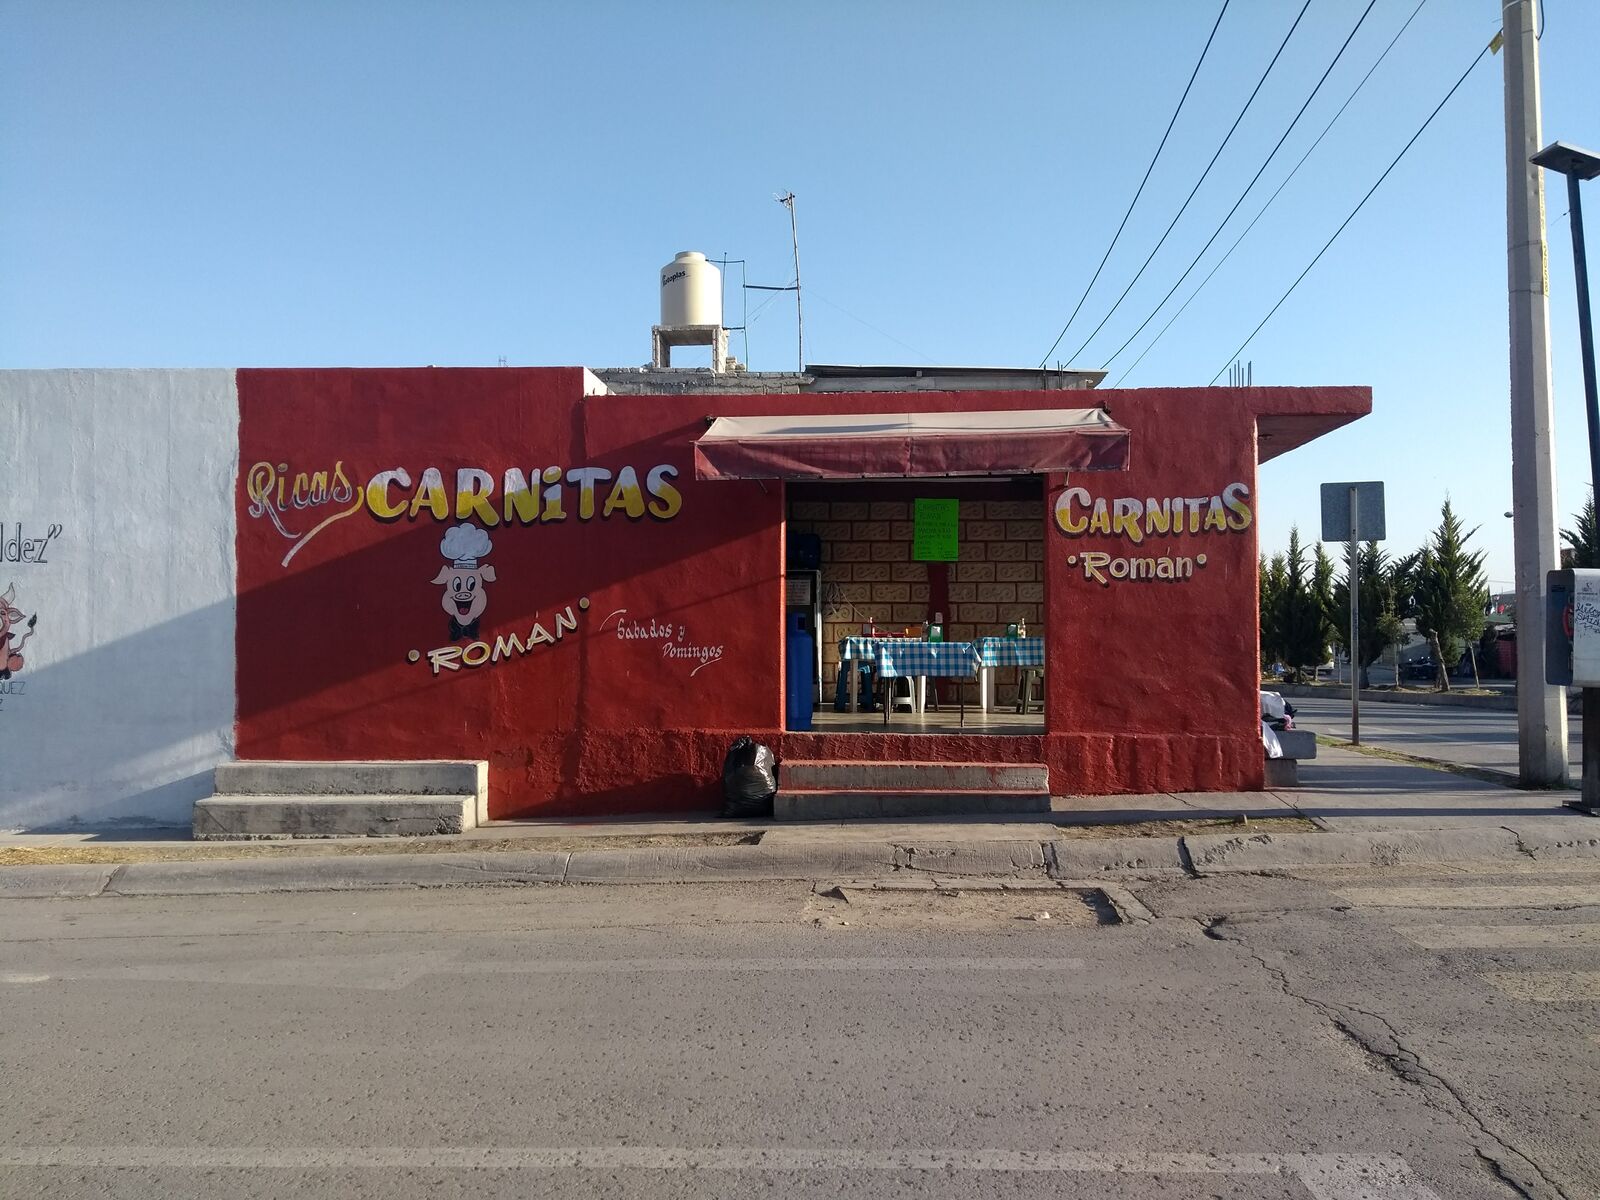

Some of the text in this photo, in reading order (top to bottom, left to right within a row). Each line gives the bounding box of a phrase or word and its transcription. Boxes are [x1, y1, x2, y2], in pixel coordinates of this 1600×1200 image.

[247, 461, 353, 539] Ricas
[1055, 482, 1253, 543] CARNITAS
[617, 617, 686, 642] Sábados y
[662, 642, 725, 663] Domingos
